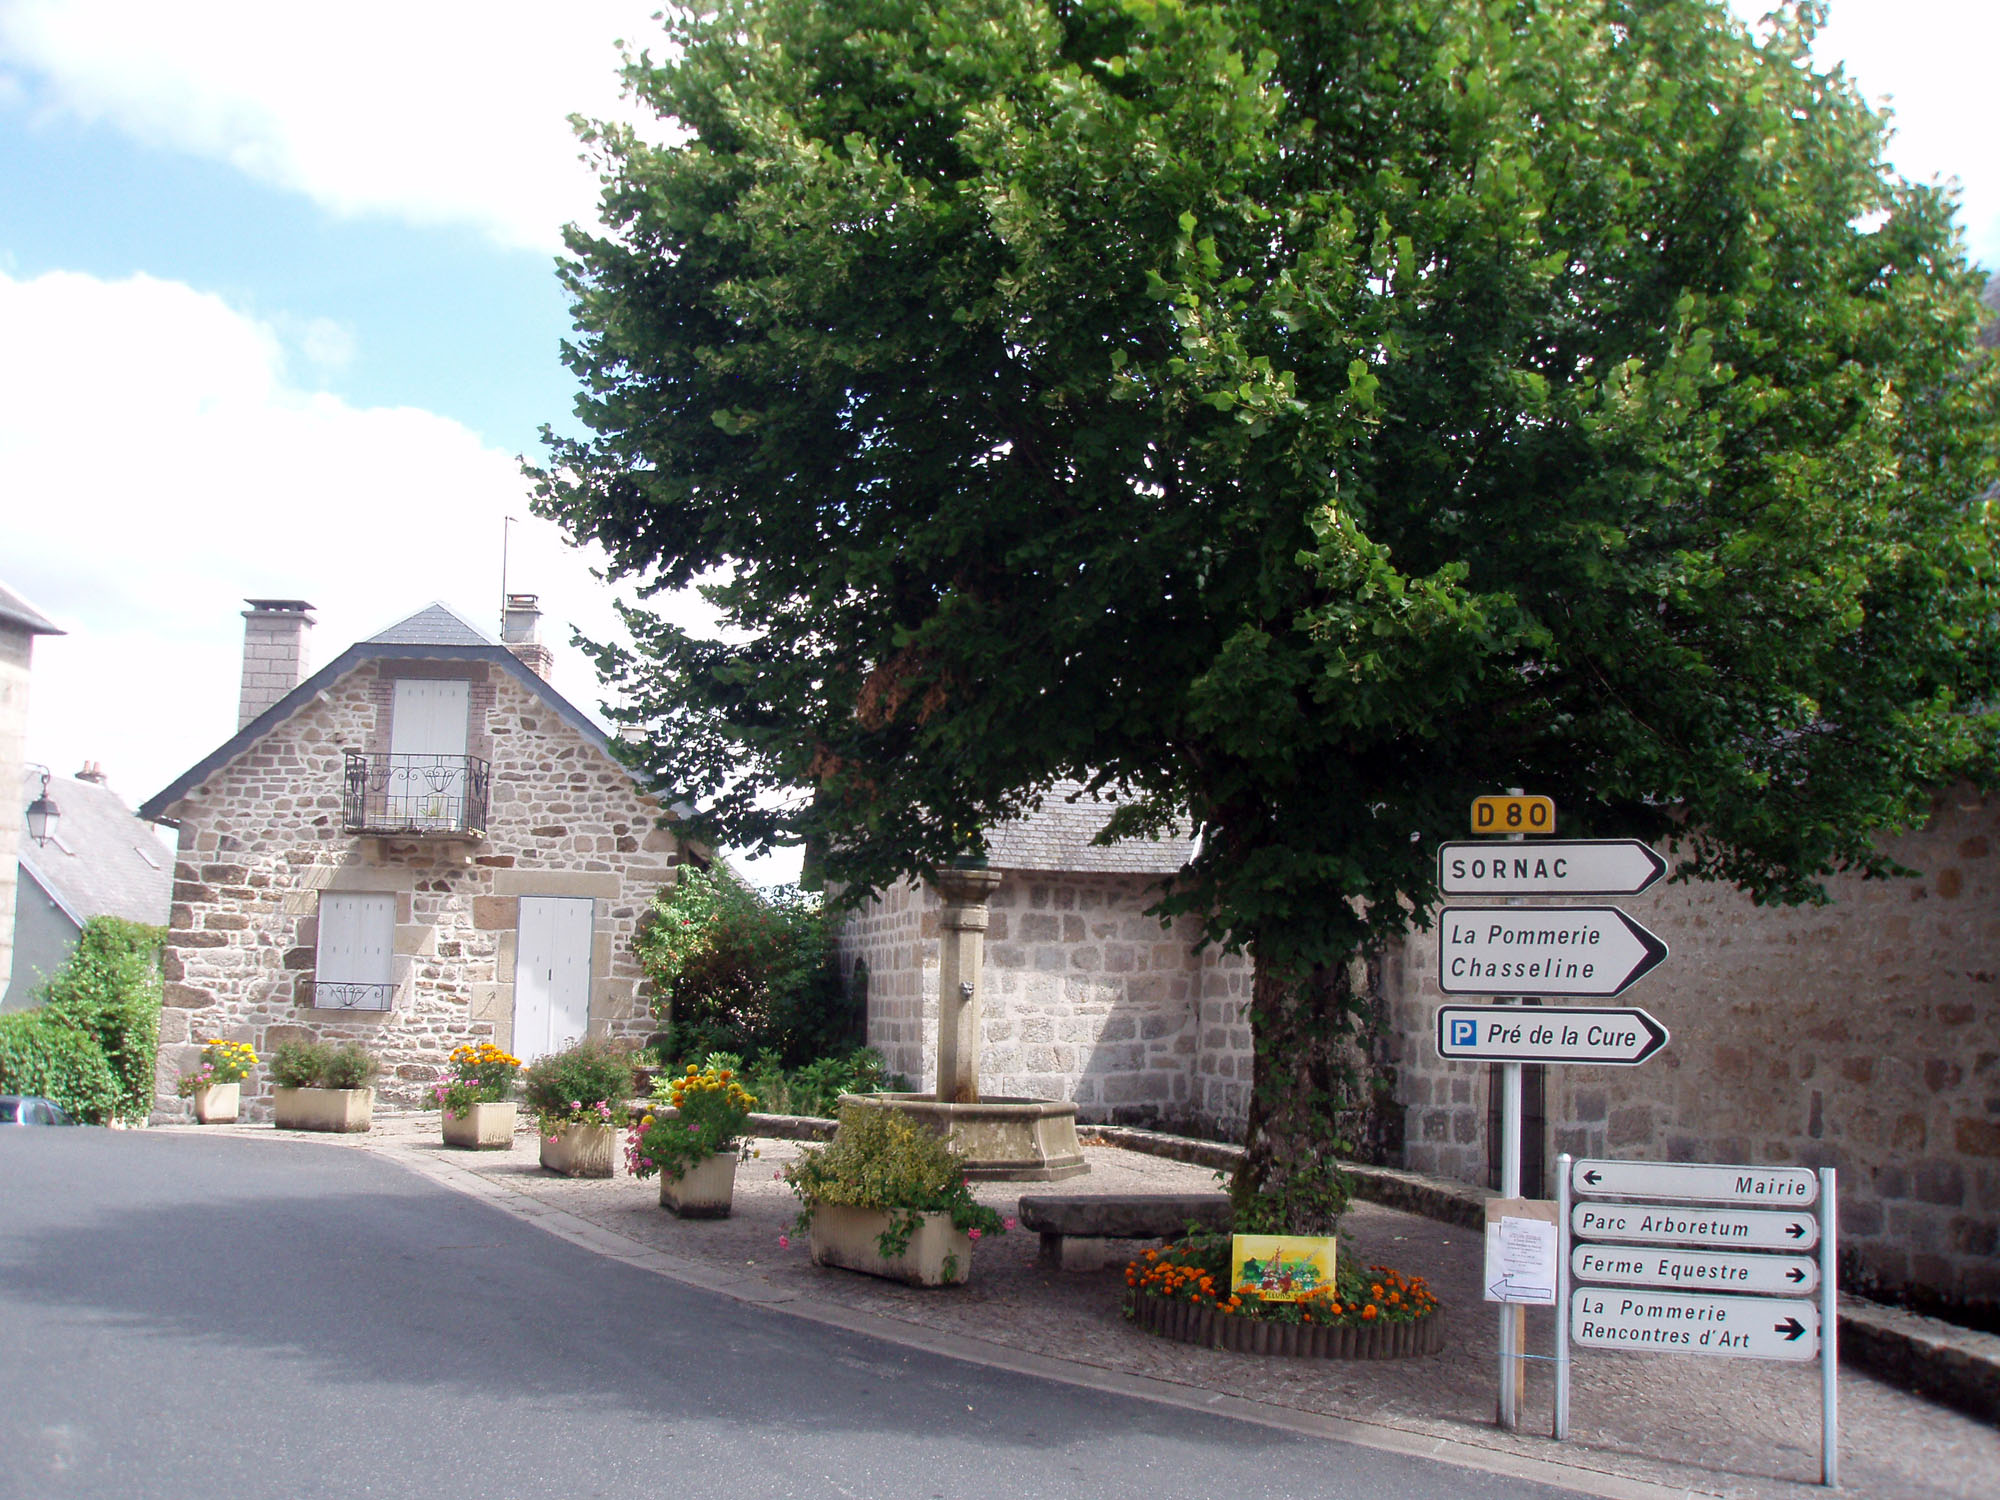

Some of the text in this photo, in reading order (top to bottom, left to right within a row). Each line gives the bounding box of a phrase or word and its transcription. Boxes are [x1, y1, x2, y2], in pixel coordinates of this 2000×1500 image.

[1478, 803, 1547, 827] D 80
[1452, 858, 1568, 879] SORNAC
[1451, 924, 1600, 945] La Pommerie
[1451, 957, 1594, 978] Chasseline
[1455, 1022, 1636, 1047] P Pré de la Cure
[1735, 1176, 1806, 1196] Mairie
[1583, 1212, 1749, 1237] Parc Arboretum
[1582, 1255, 1749, 1281] Ferme Equestre
[1582, 1297, 1727, 1322] La Pommerie
[1581, 1321, 1750, 1349] Rencontres d'Art
